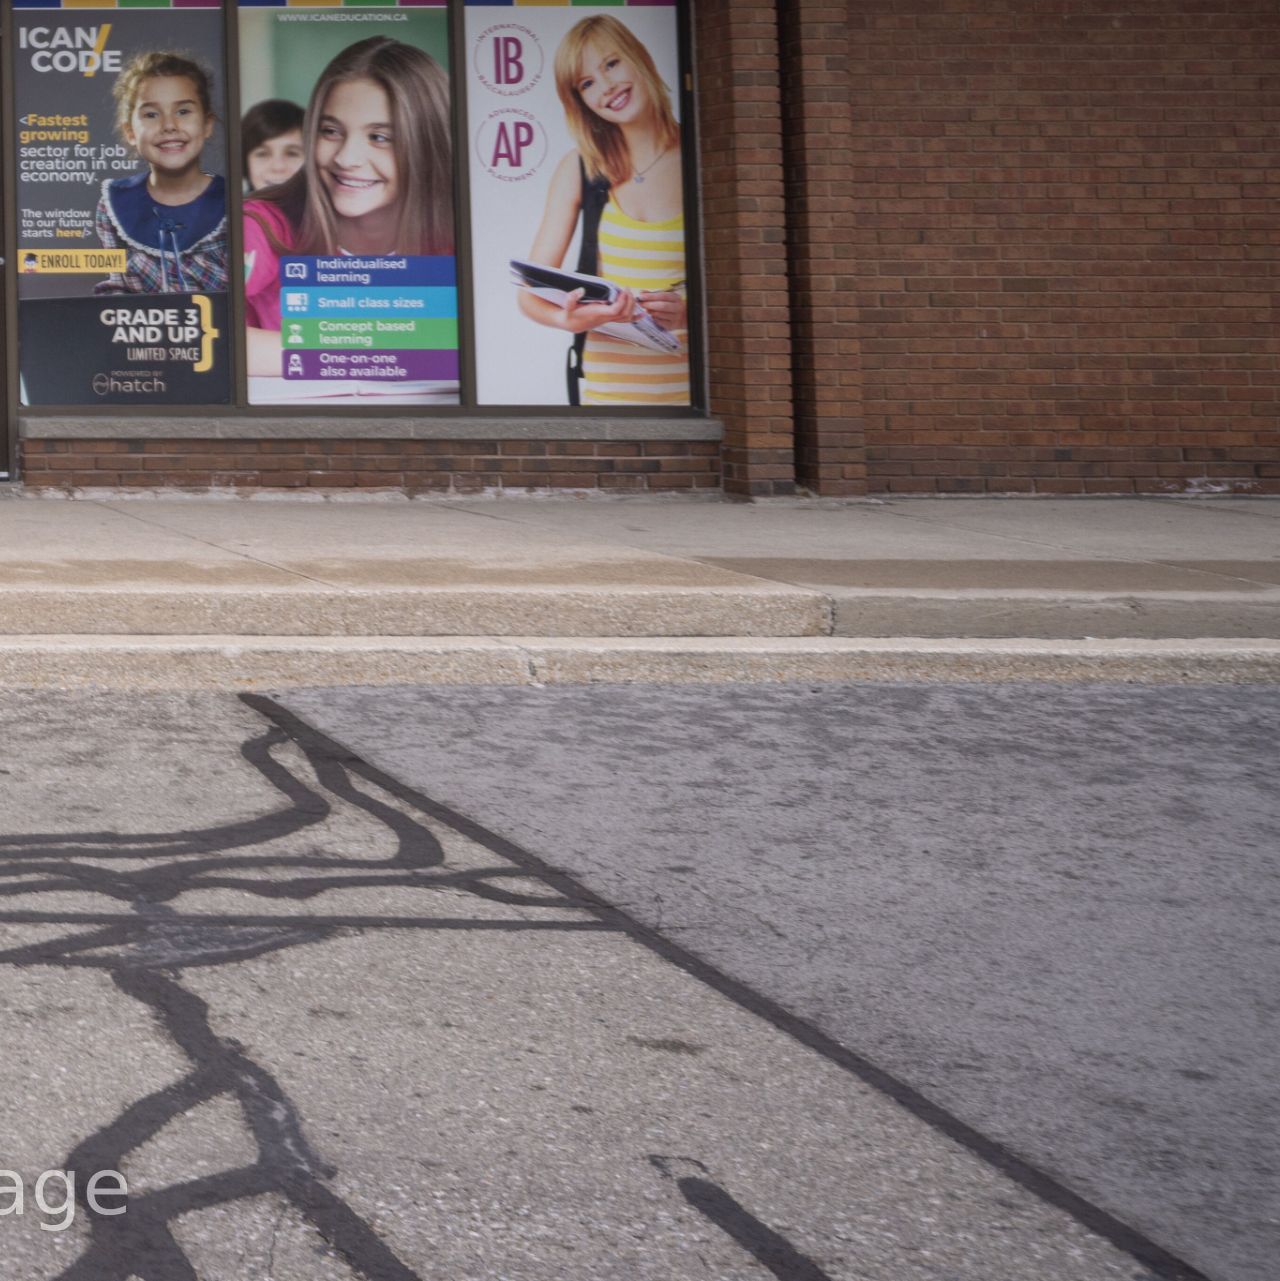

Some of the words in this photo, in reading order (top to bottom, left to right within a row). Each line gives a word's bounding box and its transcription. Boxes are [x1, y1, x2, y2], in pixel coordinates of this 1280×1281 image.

[277, 14, 408, 22] WWW.ICANEDUCATION.CA
[477, 23, 540, 42] INTERNATIONAL
[31, 51, 122, 73] CODE
[493, 37, 524, 84] IB
[20, 128, 89, 144] growing
[491, 121, 533, 167] AP
[20, 146, 69, 157] sector
[74, 145, 96, 157] for
[99, 145, 126, 160] job
[20, 158, 87, 170] creation
[92, 158, 107, 170] in
[111, 160, 138, 170] our
[21, 172, 98, 184] economy.
[22, 209, 42, 218] The
[45, 209, 90, 218] window
[22, 219, 34, 228] to
[59, 218, 93, 228] future
[22, 229, 53, 238] starts
[41, 255, 81, 268] ENROLL
[85, 255, 122, 268] TODAY!
[317, 259, 407, 269] Individualised
[317, 272, 370, 284] learning
[318, 298, 354, 308] Small
[357, 297, 389, 308] class
[393, 298, 424, 308] sizes
[100, 309, 180, 325] GRADE
[185, 309, 198, 325] 3
[319, 321, 372, 333] Concept
[376, 321, 415, 331] based
[112, 327, 162, 343] AND
[168, 327, 198, 342] UP
[320, 334, 373, 346] learning
[127, 348, 166, 361] LIMITED
[169, 348, 199, 360] SPACE
[320, 354, 397, 364] One-on-one
[320, 367, 346, 376] also
[349, 366, 407, 376] available
[110, 378, 166, 393] hatch
